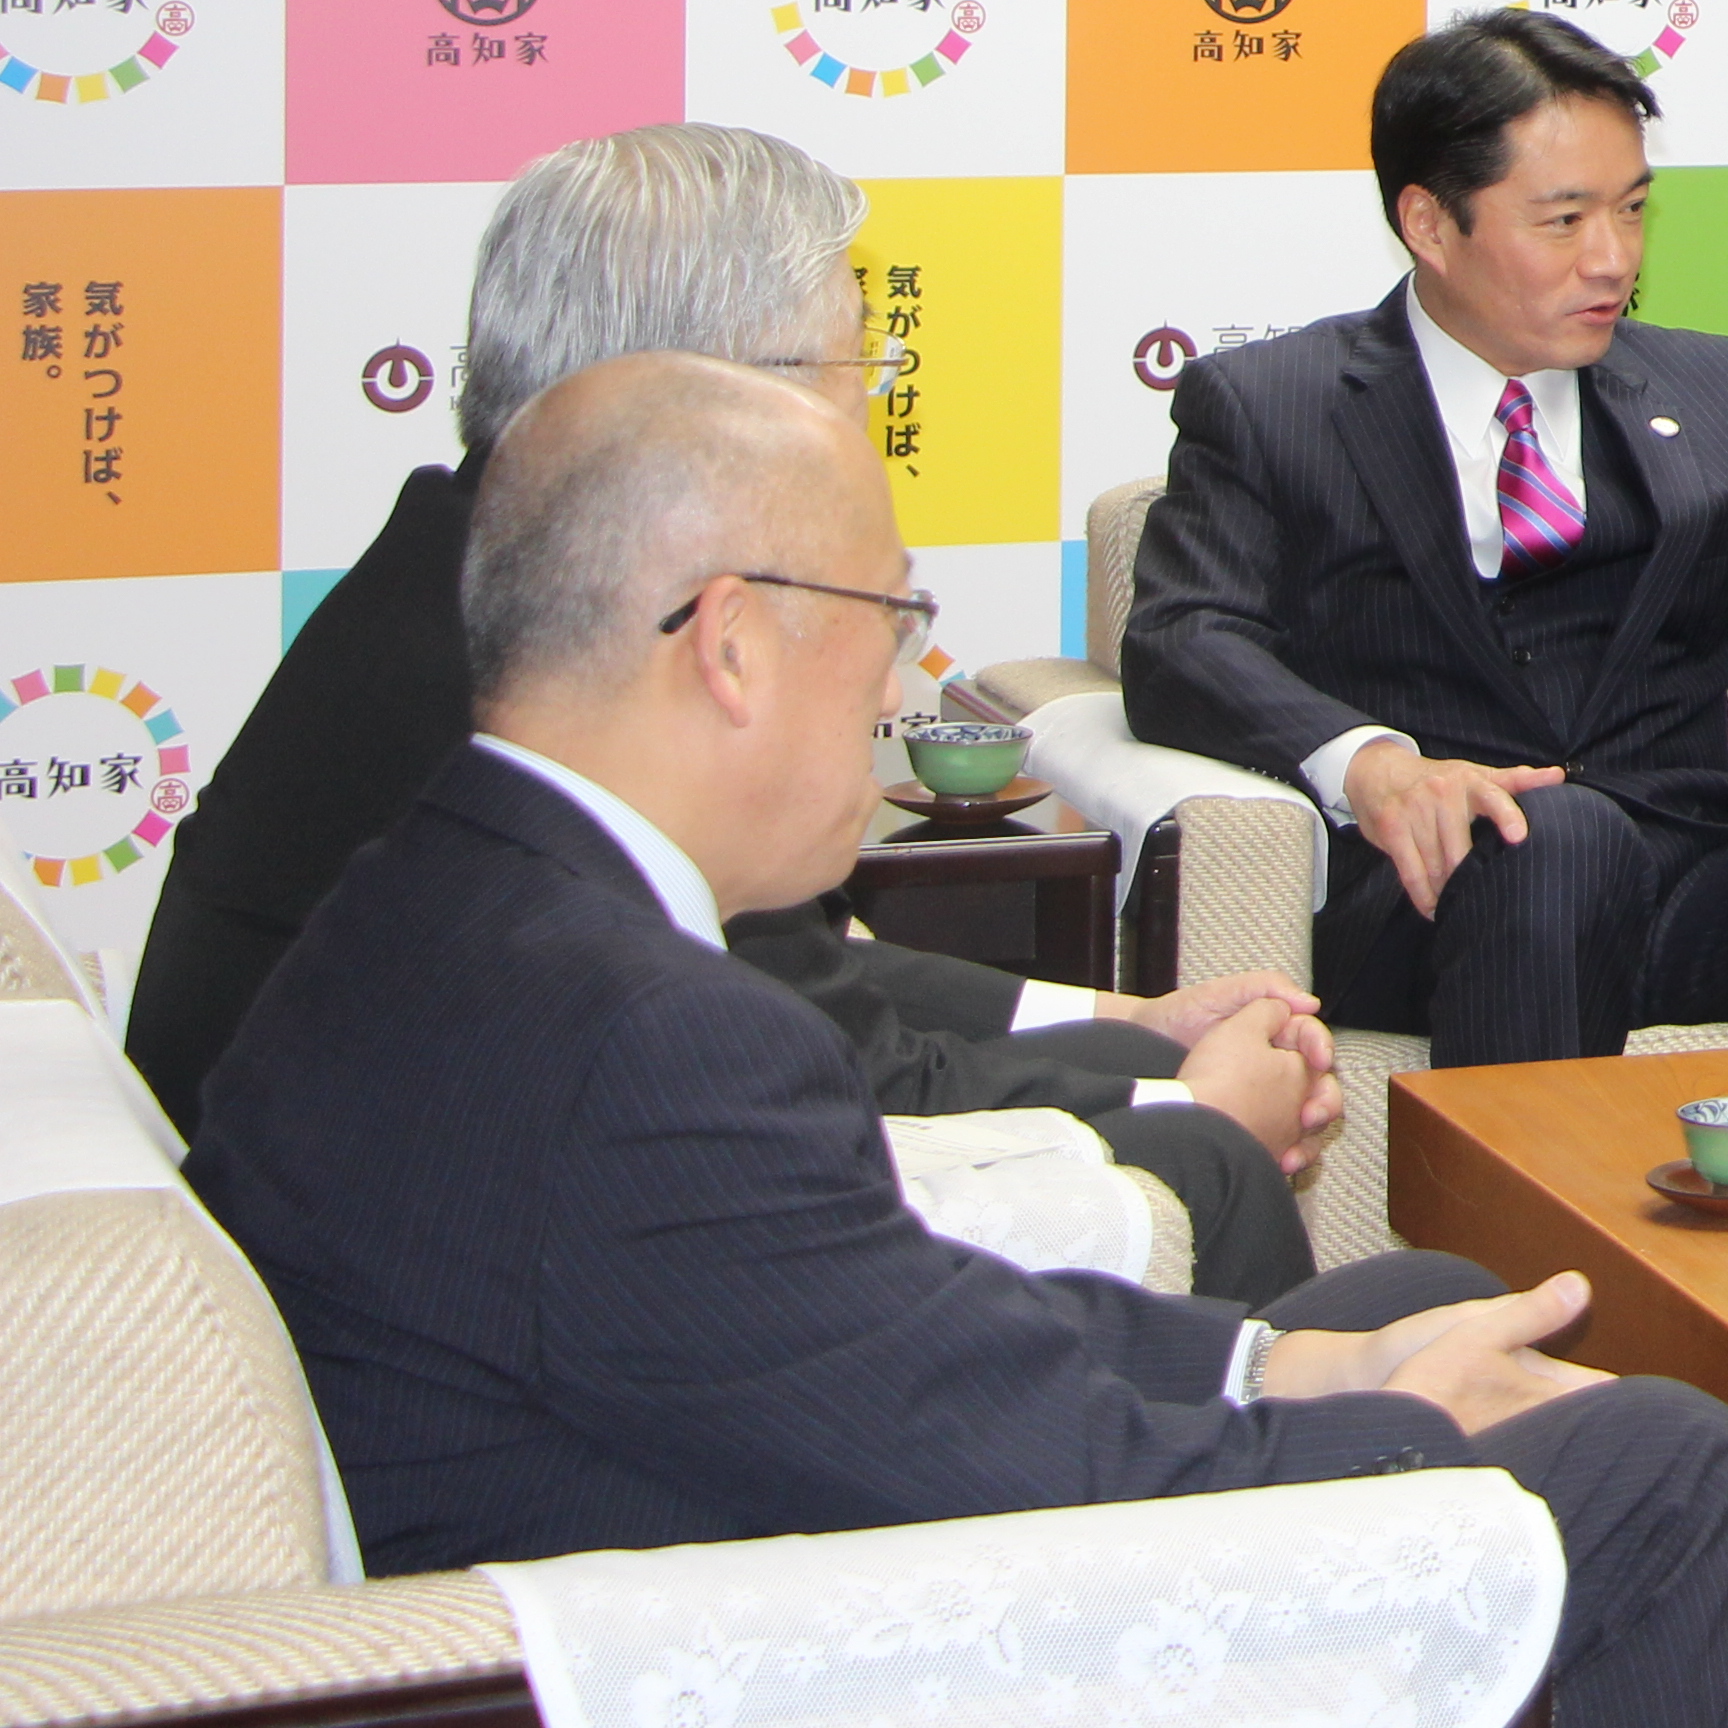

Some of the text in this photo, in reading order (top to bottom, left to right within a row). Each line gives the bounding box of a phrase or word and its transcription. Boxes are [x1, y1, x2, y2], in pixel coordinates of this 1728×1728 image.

[426, 31, 548, 67] 高知家
[1193, 29, 1302, 63] 高知家
[20, 281, 63, 379] 家族。
[82, 280, 125, 506] 気がつけば、
[0, 752, 142, 801] 高知家
